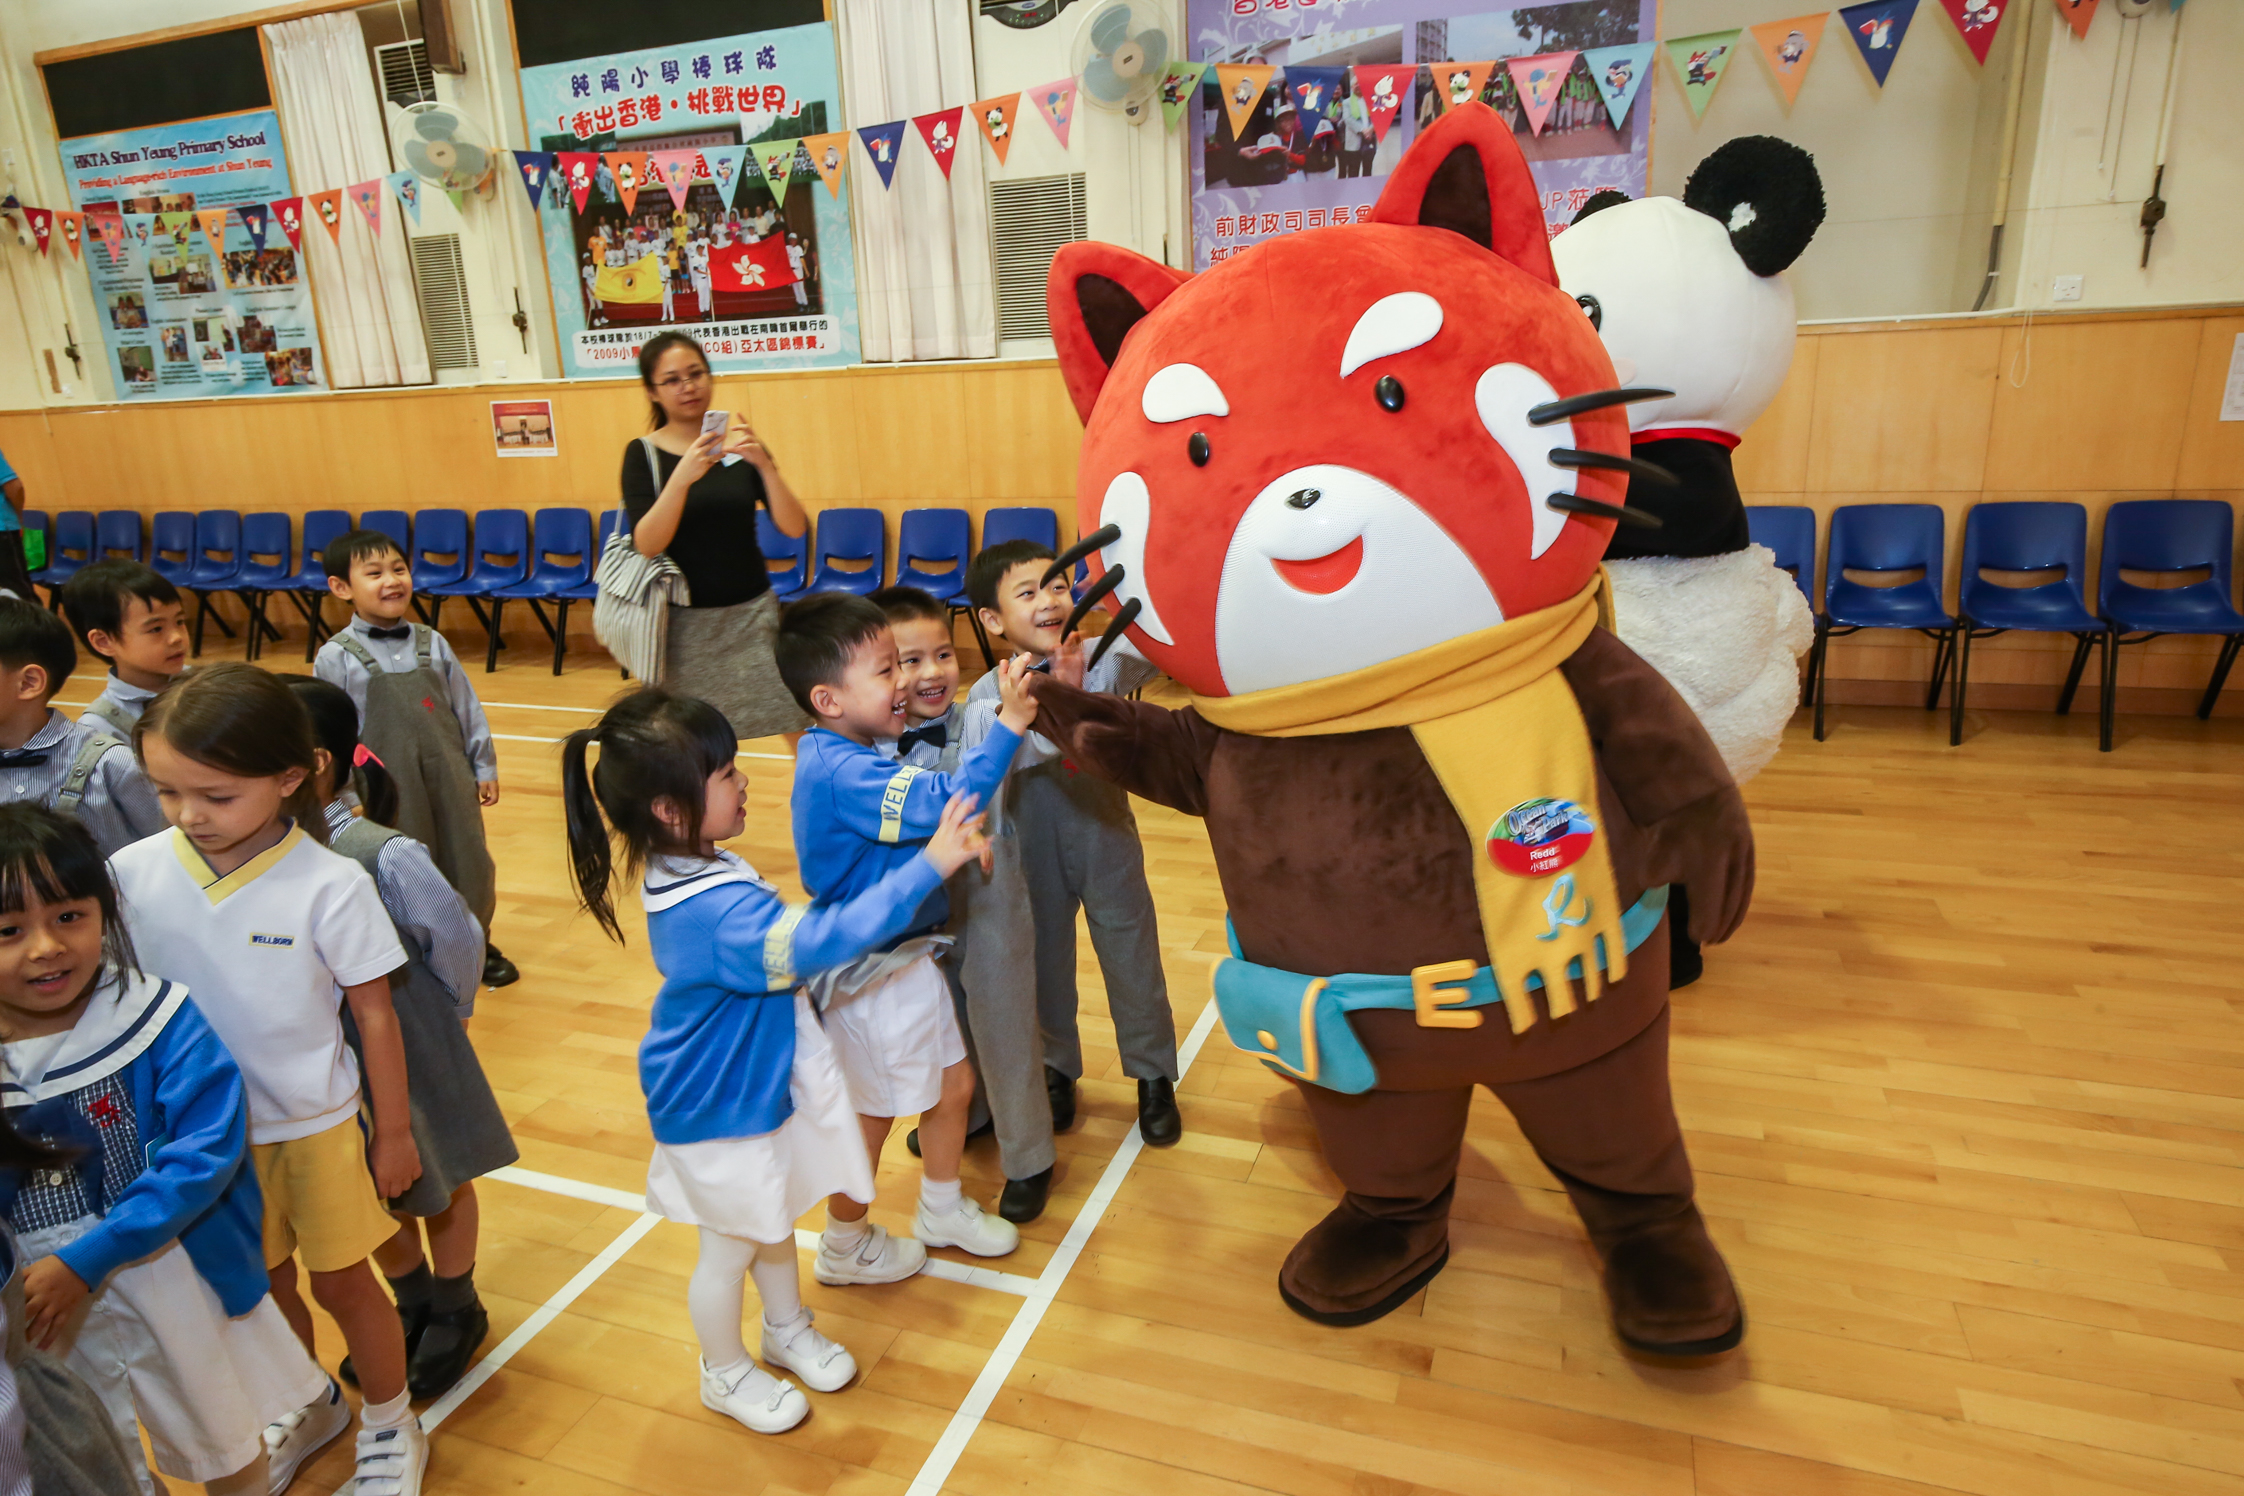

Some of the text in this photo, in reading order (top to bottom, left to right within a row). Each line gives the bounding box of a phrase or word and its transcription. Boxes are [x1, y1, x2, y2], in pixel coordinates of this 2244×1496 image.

[571, 44, 777, 98] 純陽小學棒球隊
[73, 131, 266, 169] HKTA Shun Yeung Primary School
[78, 175, 113, 190] Providing
[168, 164, 216, 179] Environment
[226, 159, 245, 172] Shun
[247, 156, 273, 170] Yeung
[1506, 806, 1547, 836] Ocean
[1542, 809, 1569, 834] Park
[1530, 847, 1556, 860] Redd
[252, 935, 294, 946] WELLBORN
